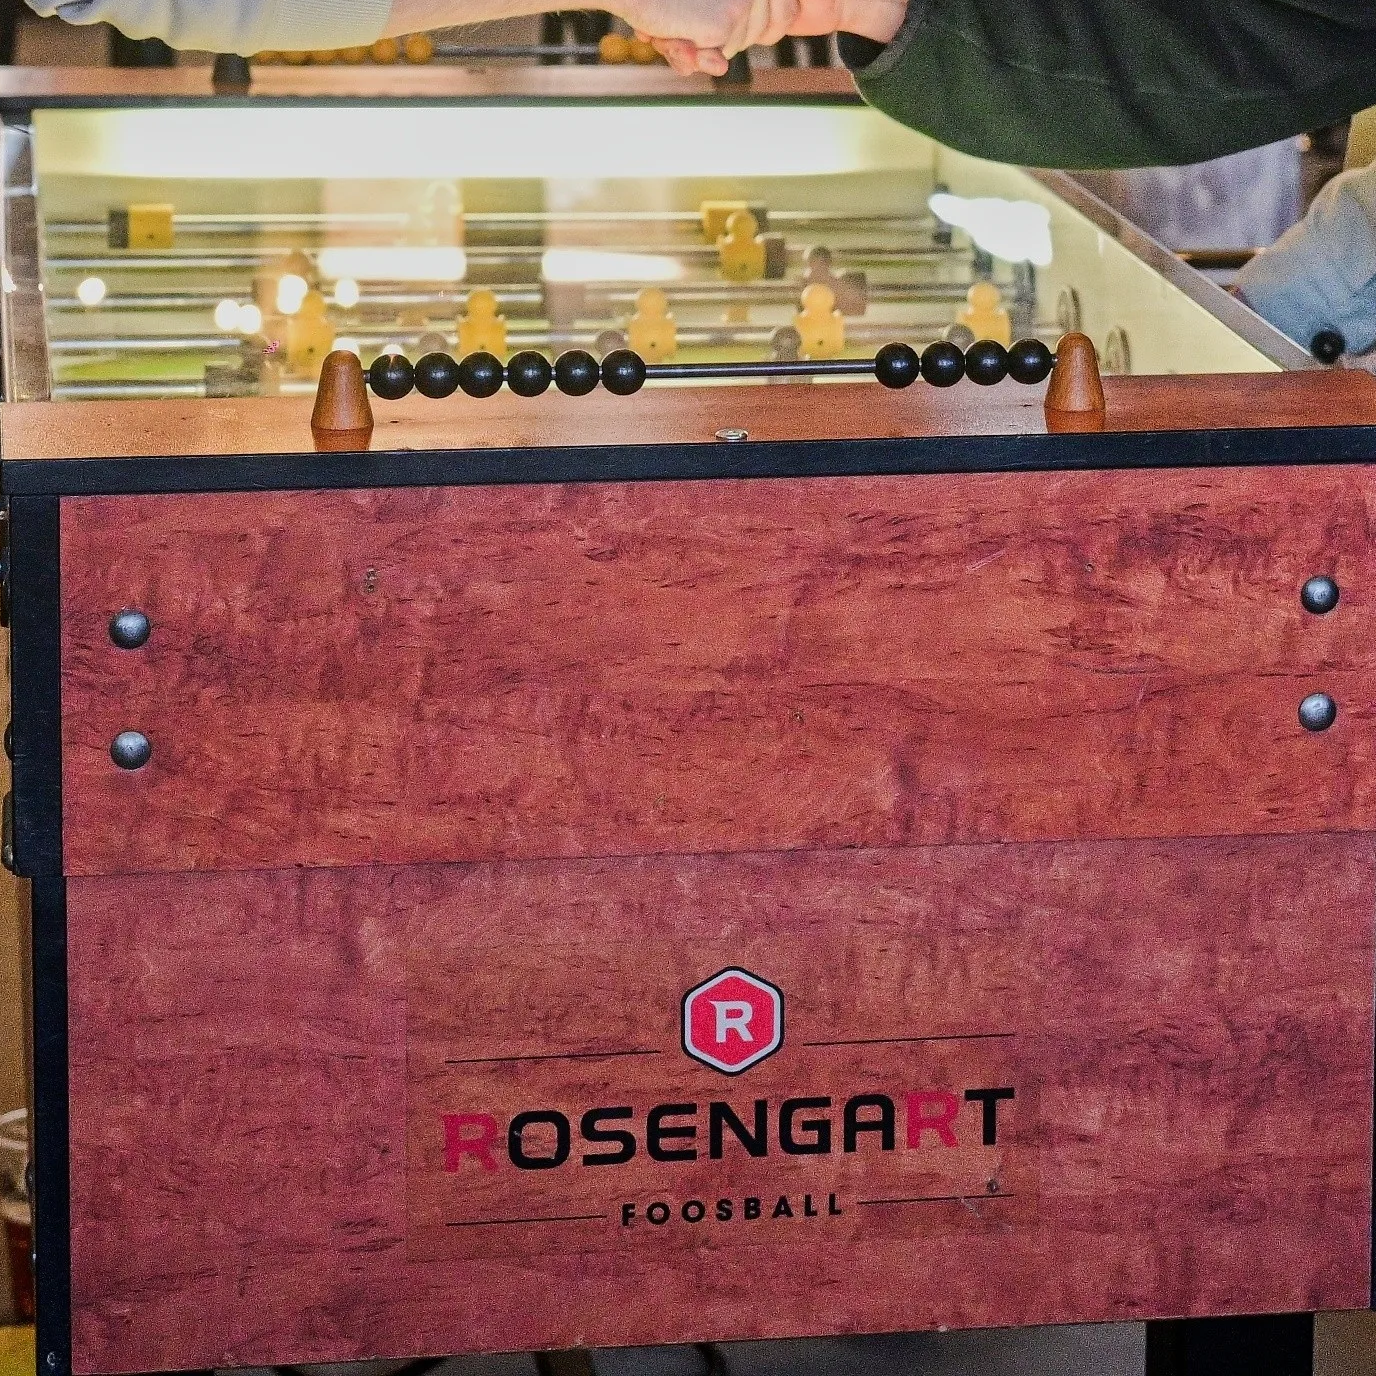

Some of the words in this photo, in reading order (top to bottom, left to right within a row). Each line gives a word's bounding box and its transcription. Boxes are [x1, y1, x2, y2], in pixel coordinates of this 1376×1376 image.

[708, 998, 754, 1044] R
[442, 1087, 1015, 1173] ROSENGART
[622, 1192, 843, 1226] FOOSBALL
